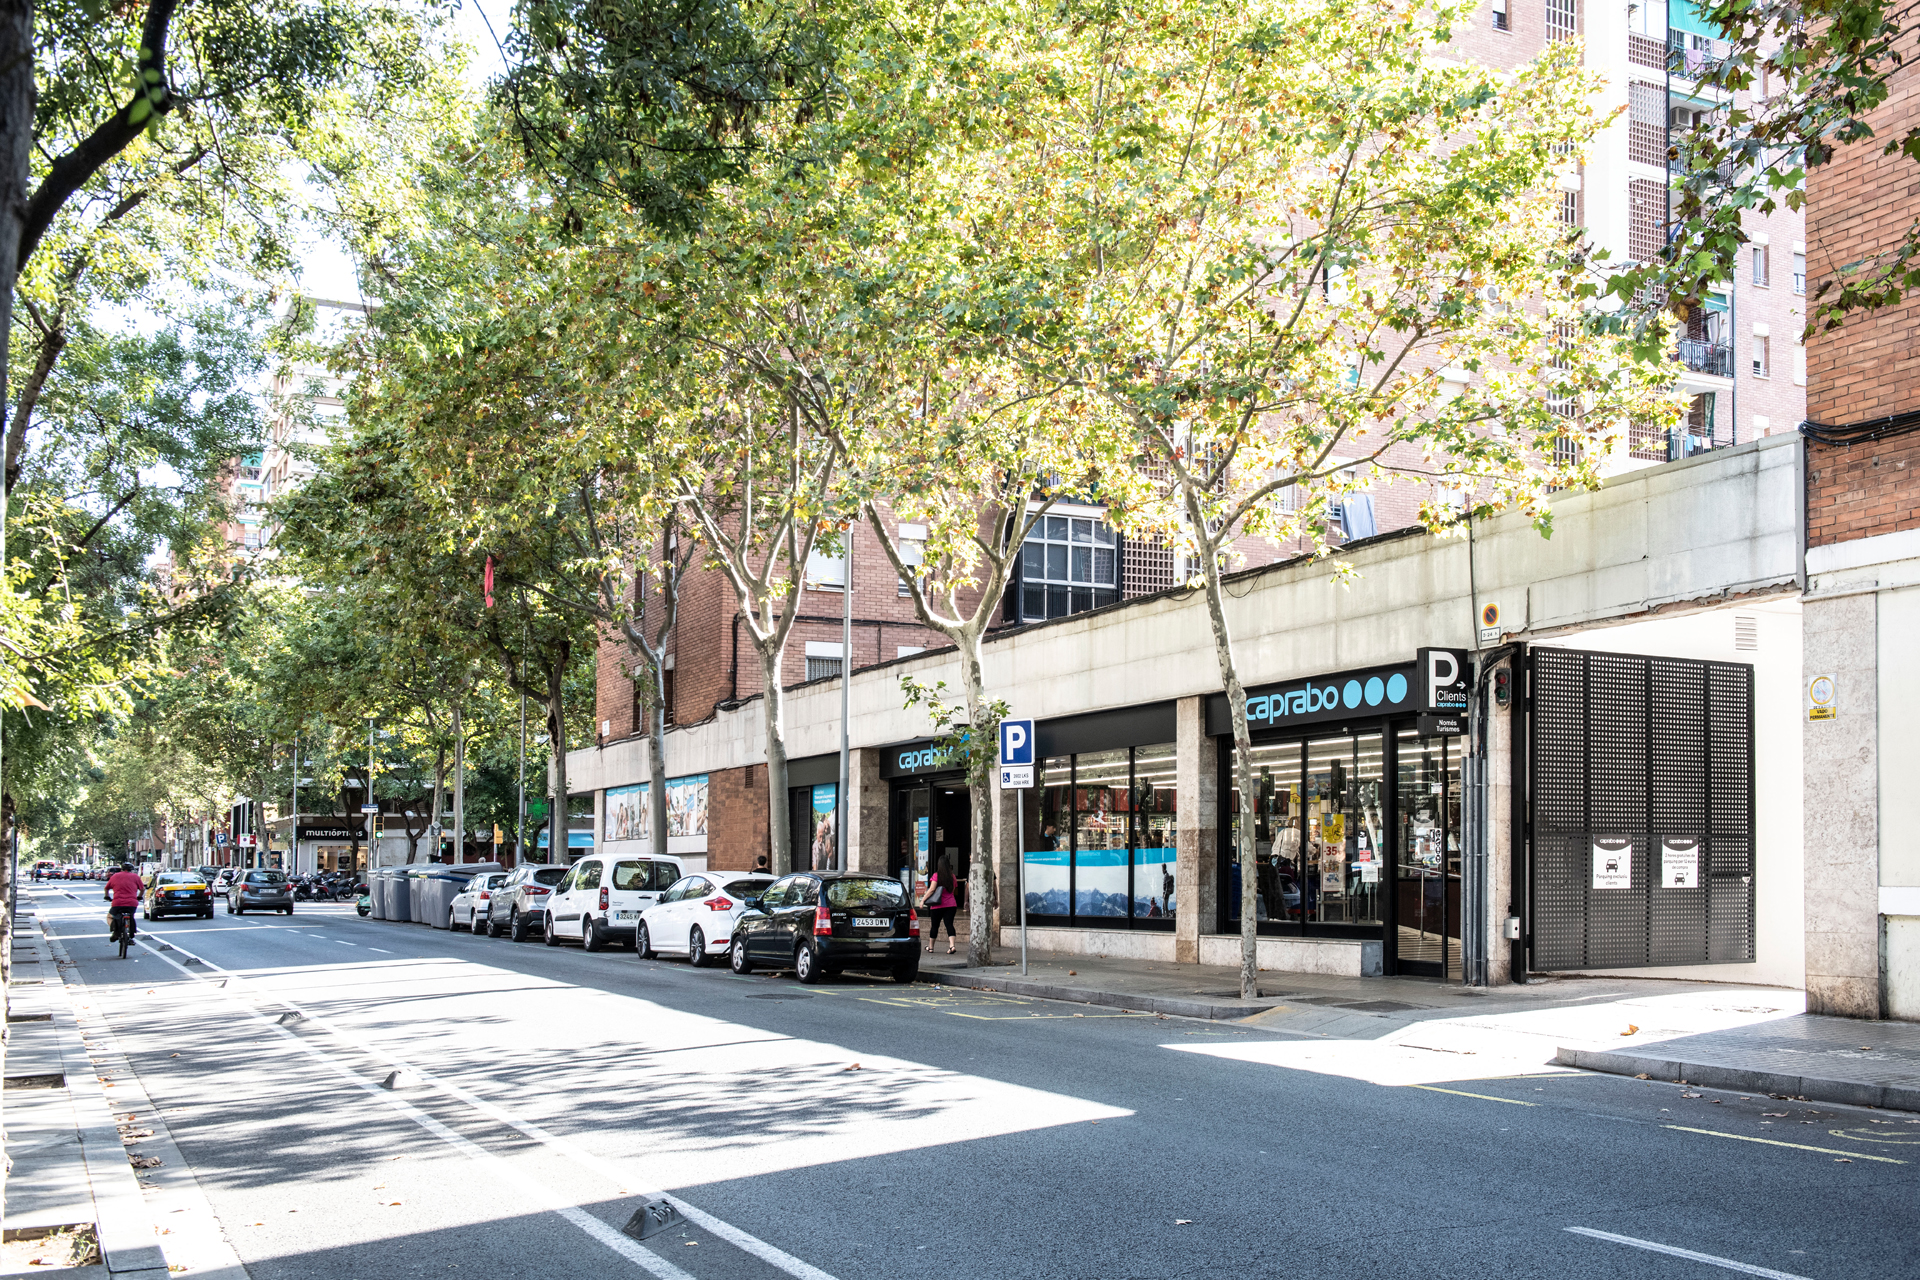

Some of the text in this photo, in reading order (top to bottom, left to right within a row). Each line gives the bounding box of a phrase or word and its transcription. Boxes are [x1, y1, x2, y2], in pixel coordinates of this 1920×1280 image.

[1428, 650, 1459, 708] P
[1436, 690, 1467, 702] Clients
[1246, 682, 1339, 725] caprabo
[1436, 725, 1460, 733] Turismes
[1438, 719, 1458, 727] Només
[1006, 724, 1027, 761] P
[217, 834, 225, 843] P
